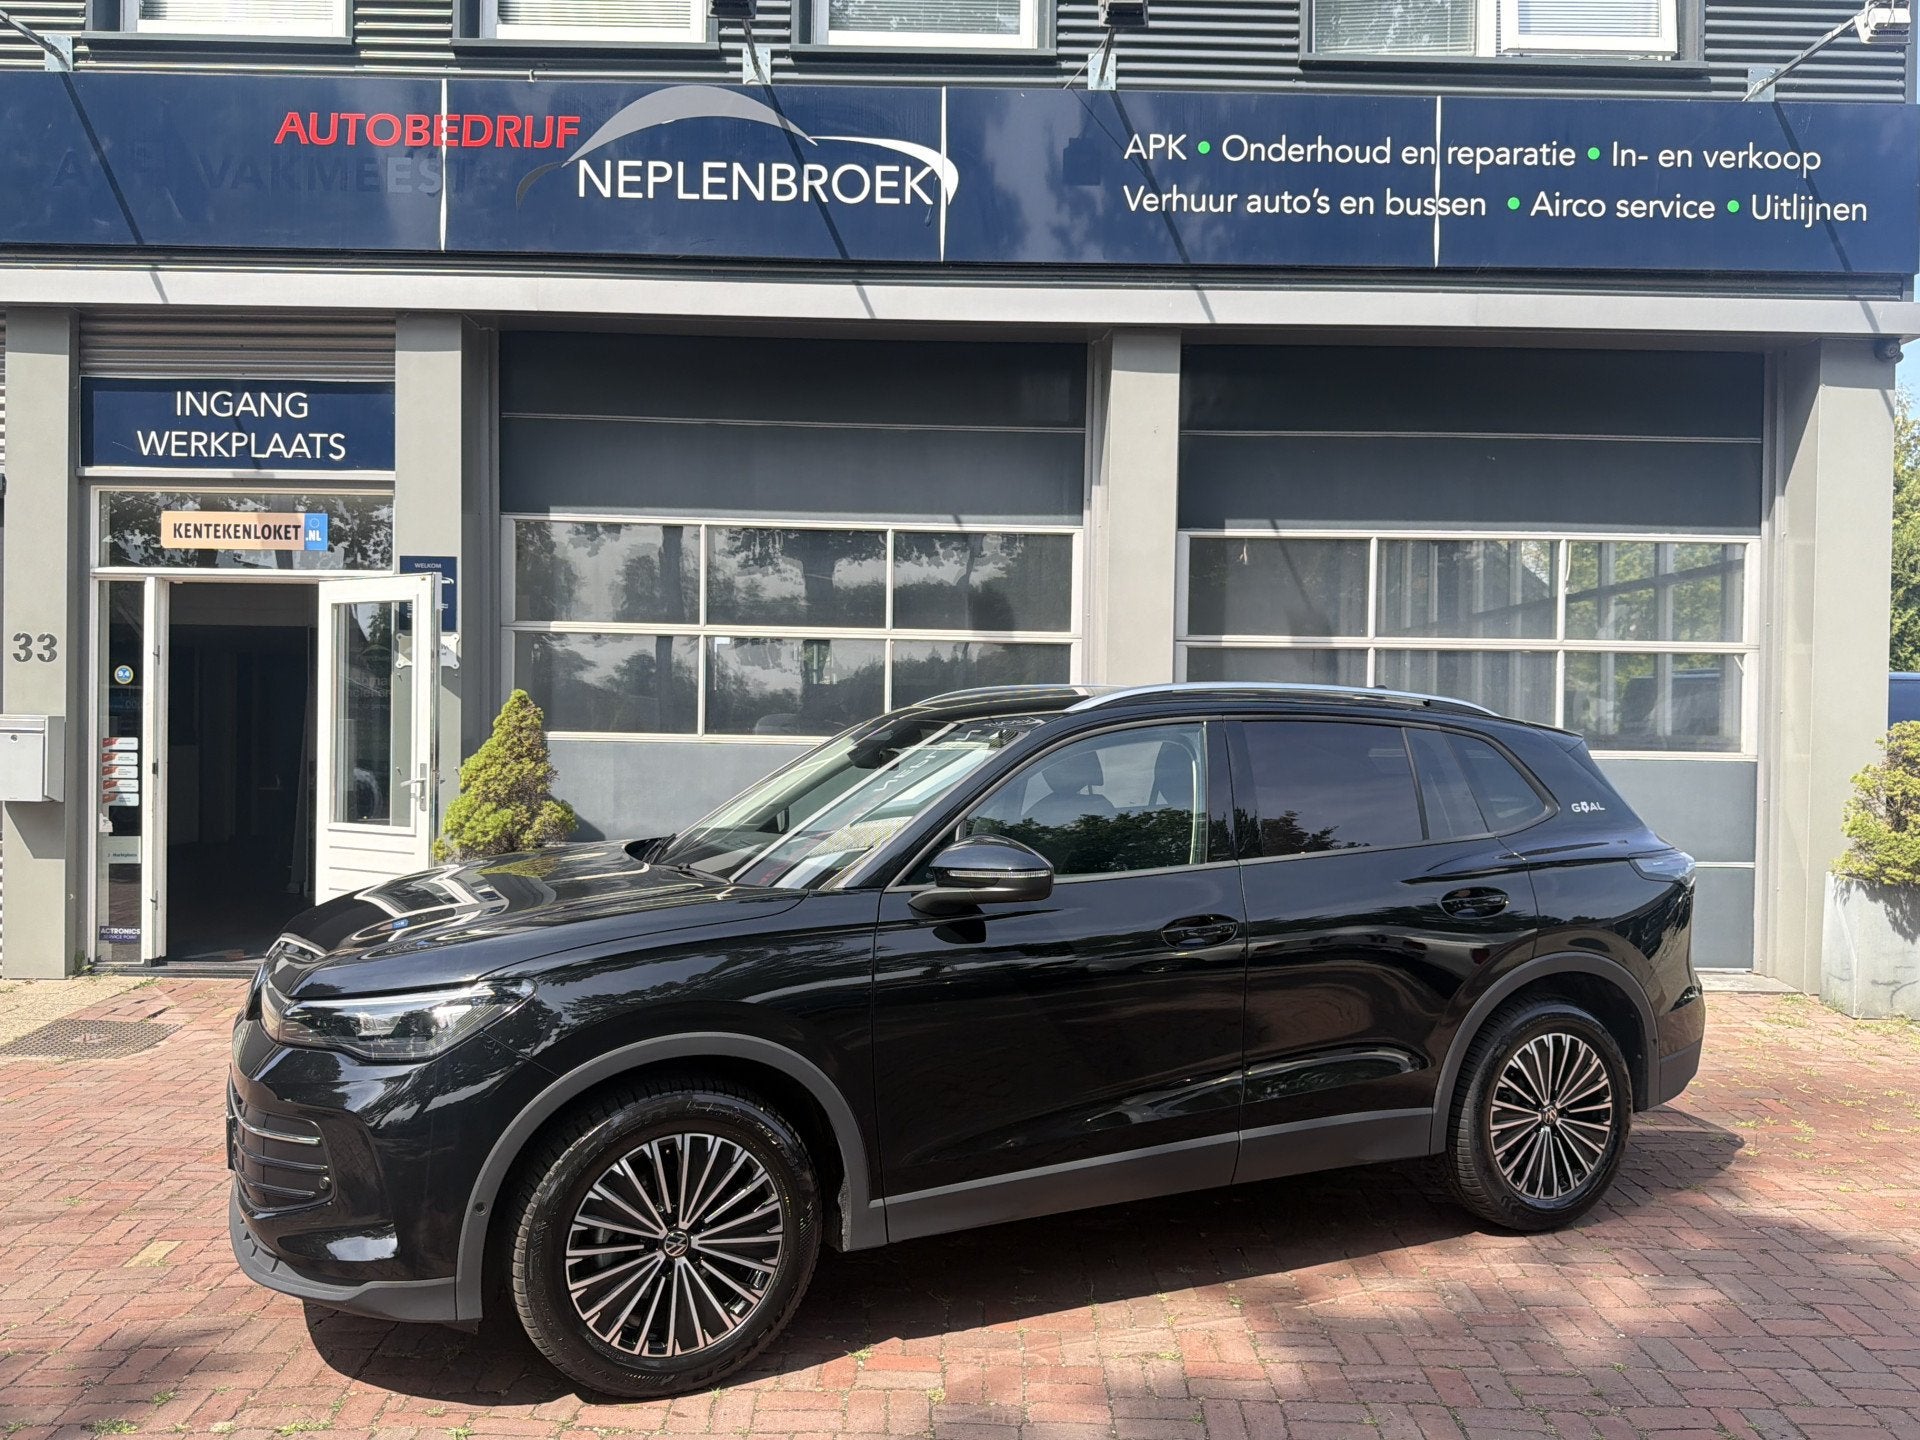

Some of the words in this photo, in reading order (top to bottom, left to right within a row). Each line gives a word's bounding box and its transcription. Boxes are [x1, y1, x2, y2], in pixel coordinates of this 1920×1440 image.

[274, 111, 581, 150] AUTOBEDRIJF
[1123, 133, 1187, 160] APK
[1221, 134, 1391, 165] Onderhoud
[1400, 144, 1437, 165] en
[1447, 140, 1576, 175] reparatie
[1612, 141, 1649, 167] In-
[1658, 152, 1692, 169] en
[1703, 142, 1821, 178] verkoop
[578, 159, 934, 206] NEPLENBROEK
[1123, 184, 1238, 213] Verhuur
[1246, 187, 1330, 215] auto's
[1339, 194, 1375, 215] en
[1385, 188, 1486, 216] bussen
[1530, 191, 1606, 218] Airco
[1615, 193, 1716, 220] service
[1751, 194, 1867, 228] Uitlijnen
[175, 390, 309, 419] INGANG
[136, 430, 346, 461] WERKPLAATS
[172, 522, 302, 541] KENTEKENLOKET
[12, 632, 58, 663] 33
[100, 927, 141, 935] ACTRONICS
